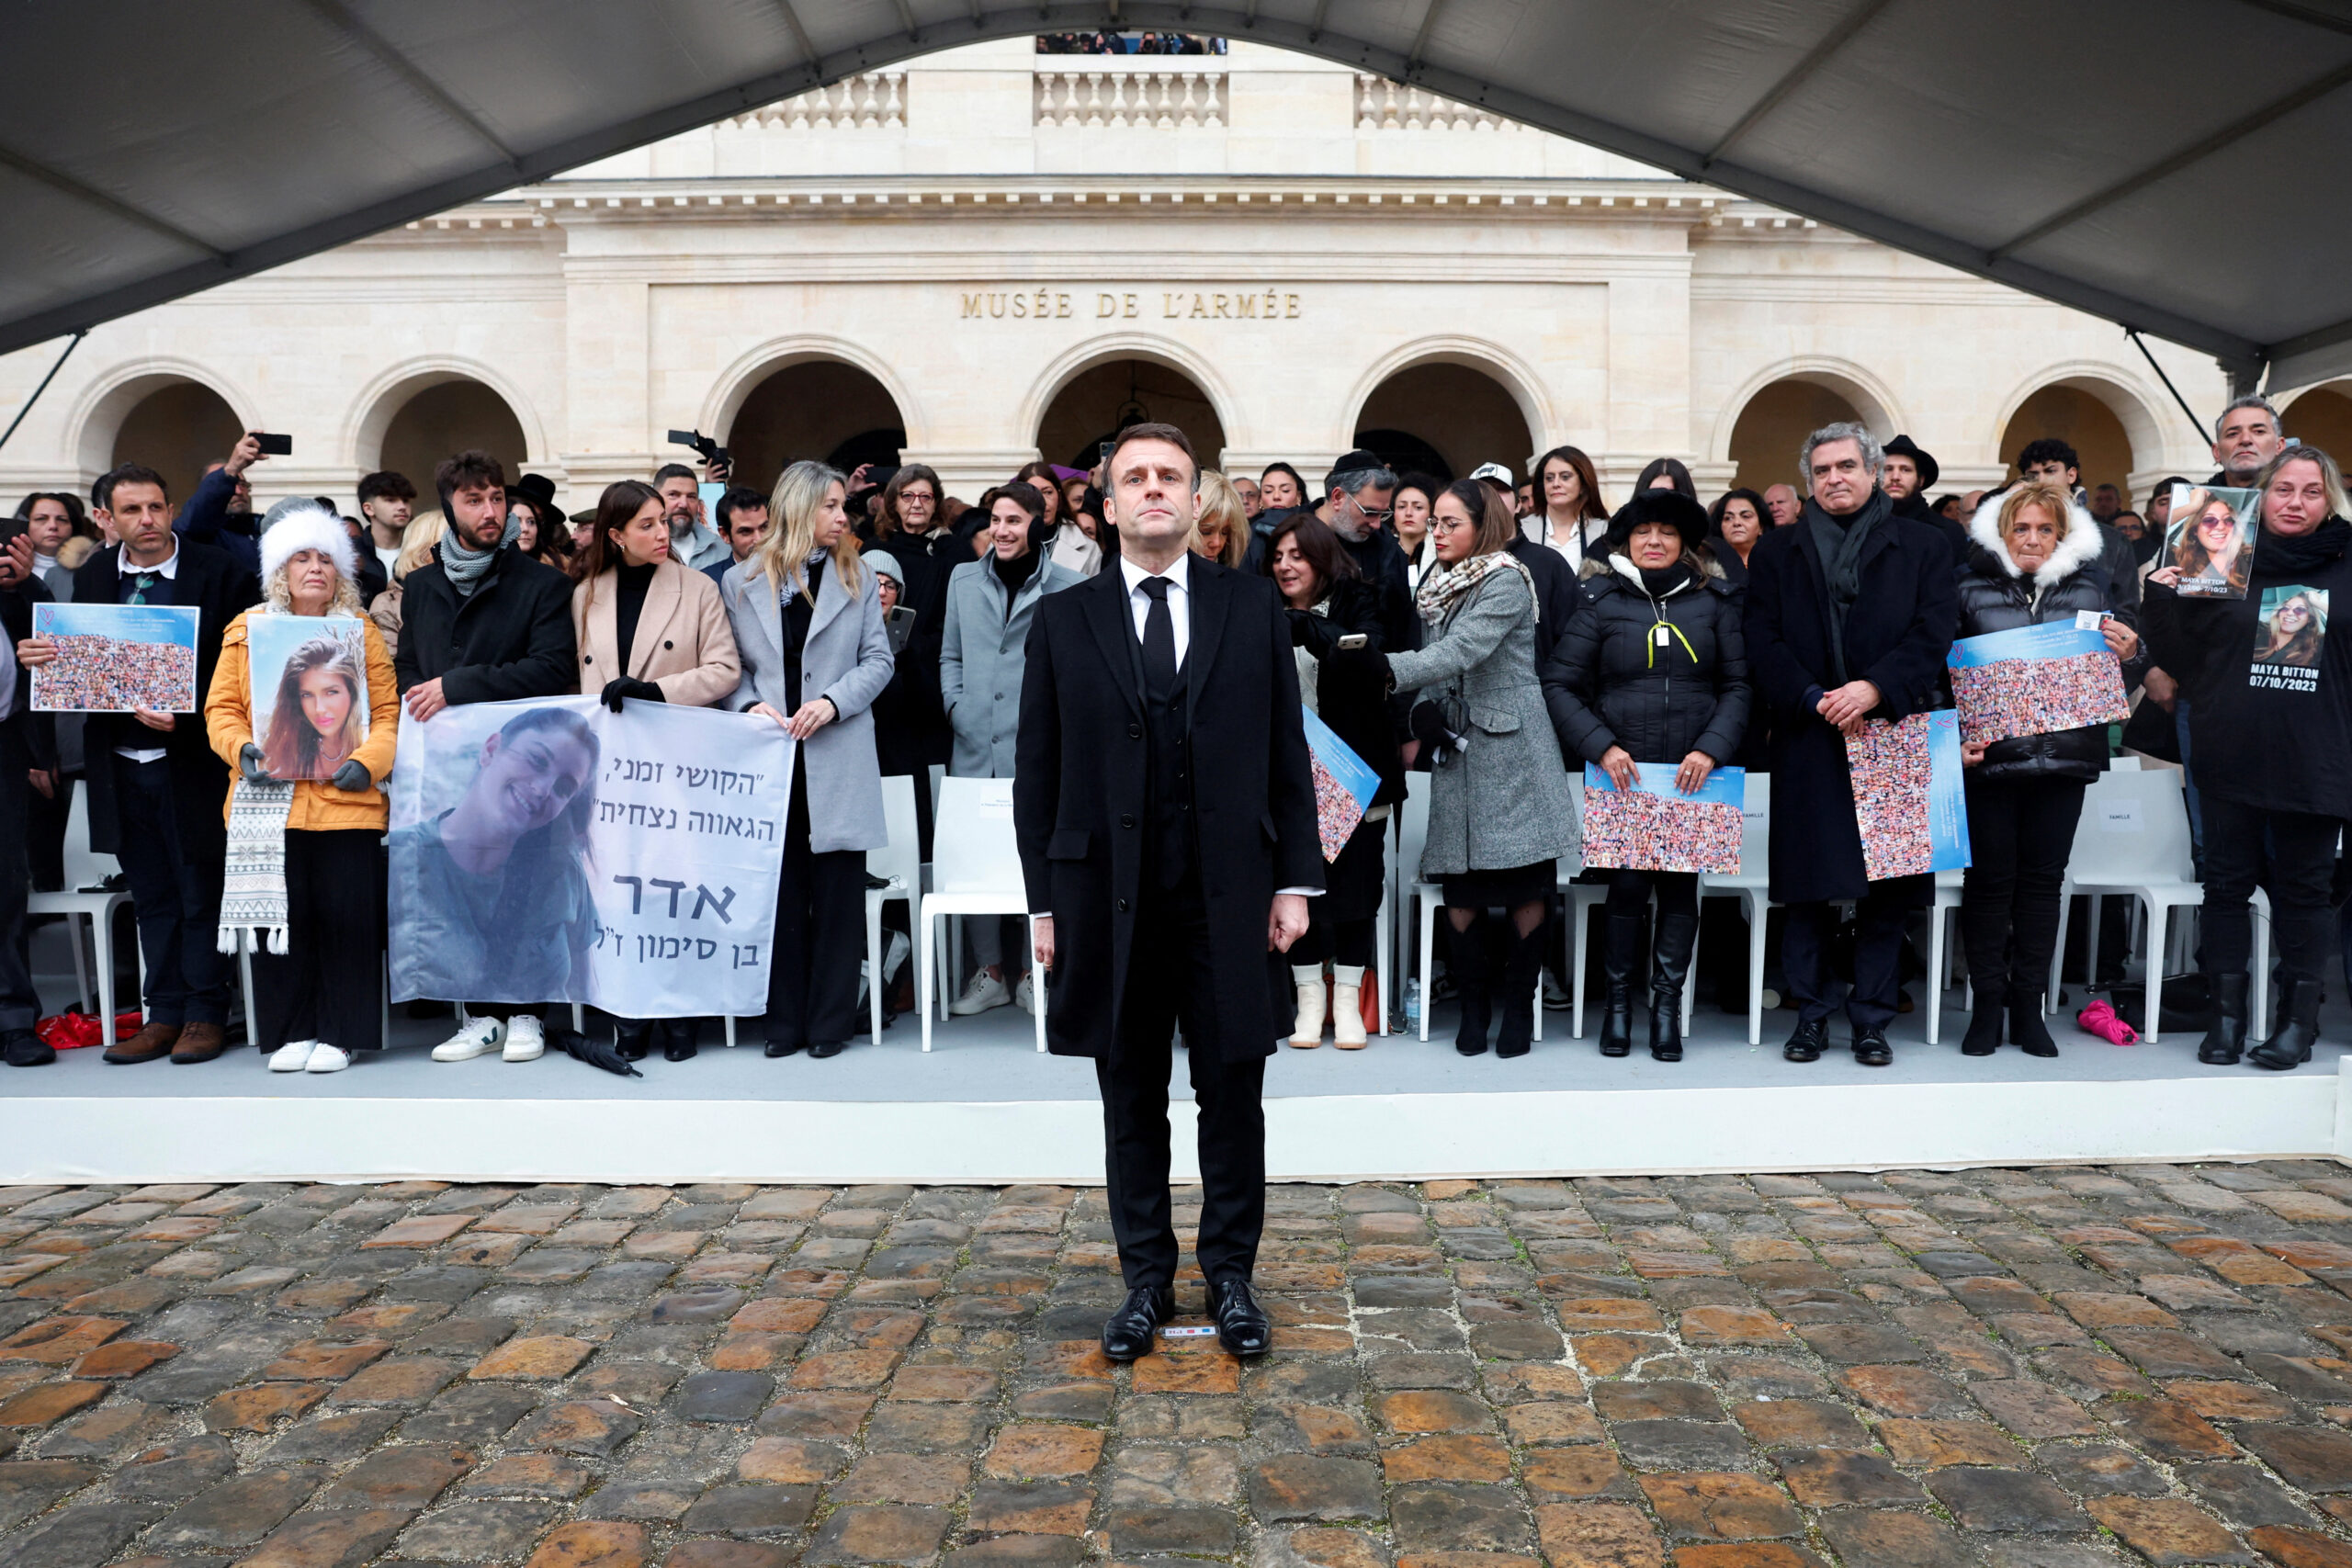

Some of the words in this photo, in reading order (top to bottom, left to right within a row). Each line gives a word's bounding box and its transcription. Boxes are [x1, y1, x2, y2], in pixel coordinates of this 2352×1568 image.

[961, 288, 1074, 320] MUSÉE
[1095, 292, 1140, 320] DE
[1161, 288, 1303, 320] L'ARMÉE
[2200, 578, 2226, 586] BITTON
[2248, 675, 2317, 693] 07/10/2023
[2250, 663, 2279, 676] MAYA
[2281, 666, 2320, 680] BITTON
[687, 809, 775, 841] הגאווה
[613, 874, 737, 924] אדר
[638, 933, 718, 963] סימון
[732, 942, 760, 970] בן
